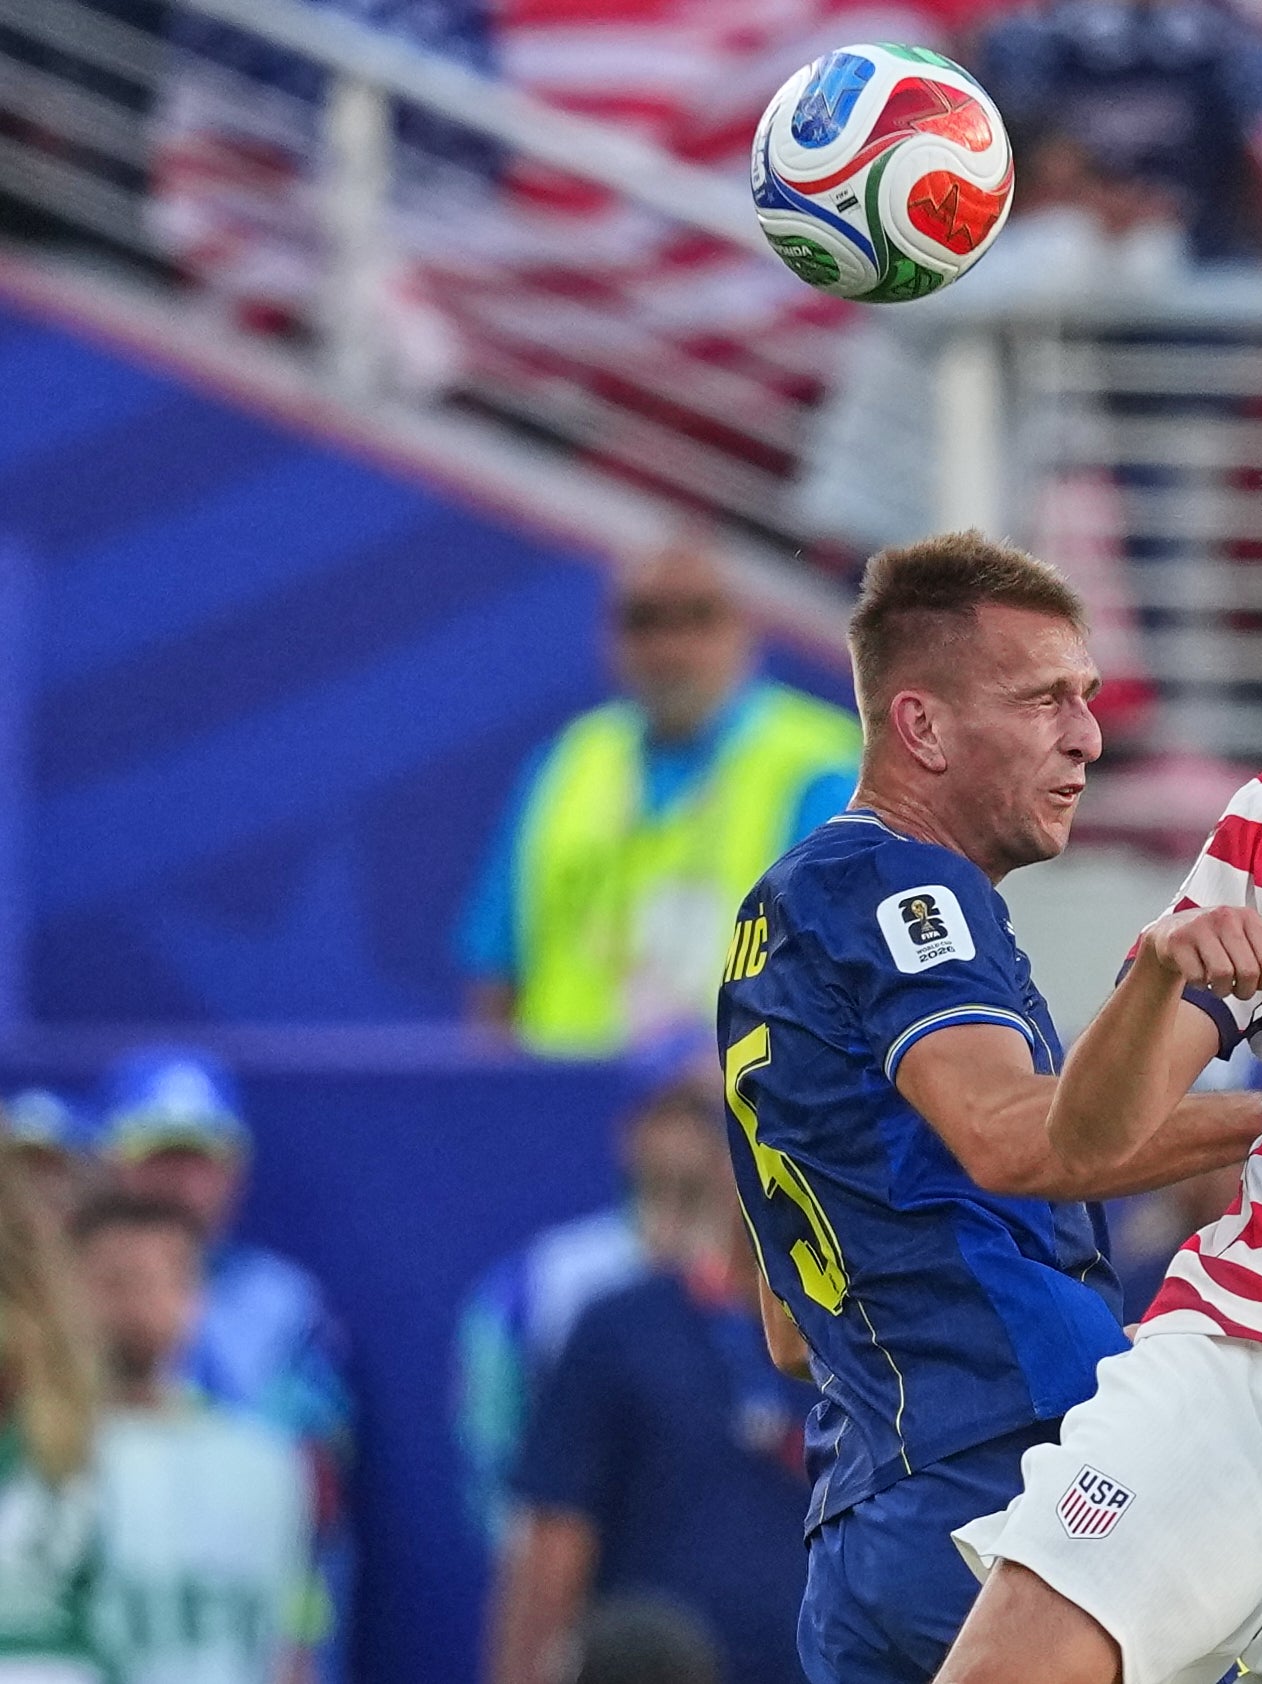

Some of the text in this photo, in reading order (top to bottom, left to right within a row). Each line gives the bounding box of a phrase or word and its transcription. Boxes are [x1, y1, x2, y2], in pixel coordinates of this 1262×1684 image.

[920, 930, 941, 941] FIFA
[916, 942, 940, 955] WORLD
[919, 945, 956, 963] 2026
[1079, 1470, 1130, 1509] USA
